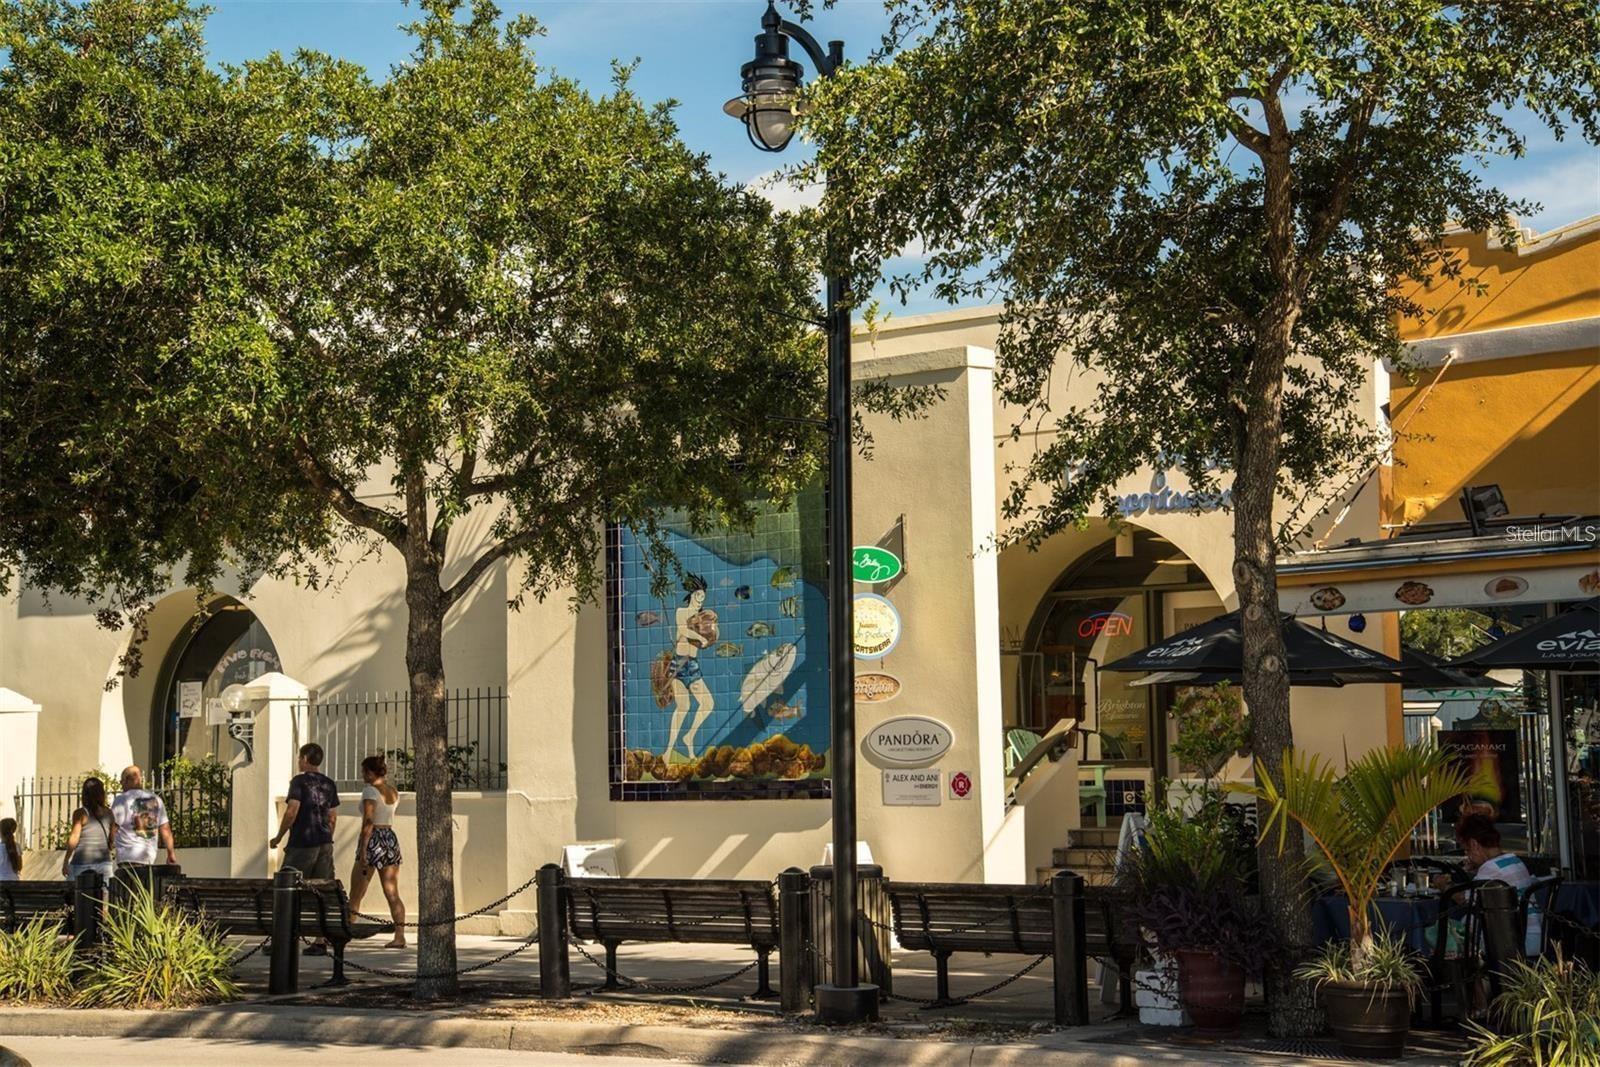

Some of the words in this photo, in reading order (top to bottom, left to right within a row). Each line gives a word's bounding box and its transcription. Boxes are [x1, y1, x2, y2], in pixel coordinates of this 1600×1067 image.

[1078, 616, 1133, 637] OPEN
[853, 638, 891, 654] ORTSWEAR
[1536, 638, 1600, 650] evia
[892, 774, 909, 782] ALEX
[958, 781, 965, 789] R
